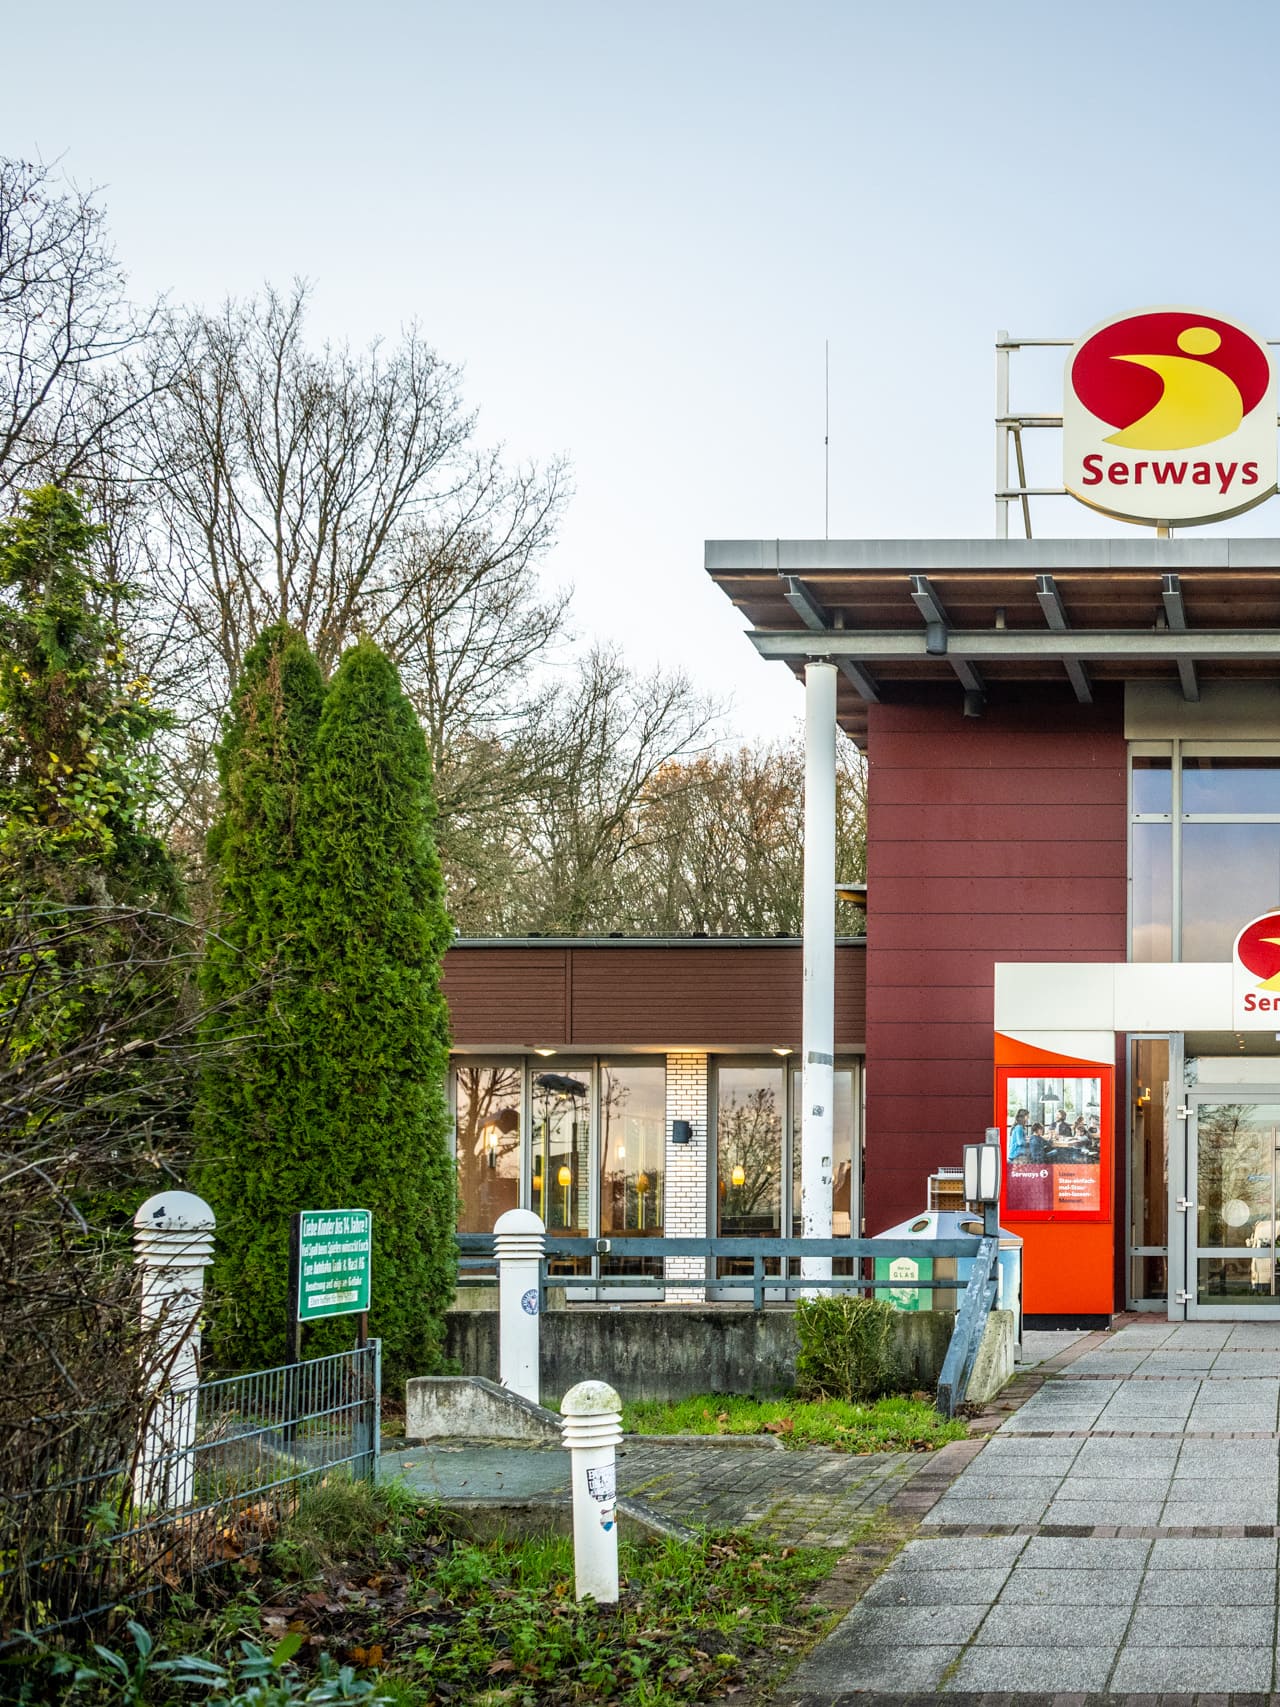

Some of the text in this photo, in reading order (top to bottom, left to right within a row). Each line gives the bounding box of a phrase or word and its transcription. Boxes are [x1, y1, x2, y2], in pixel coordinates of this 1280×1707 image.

[1082, 453, 1259, 494] Serways
[1011, 1170, 1039, 1179] Serways
[303, 1217, 318, 1237] Liebe
[318, 1217, 335, 1236] Kinder
[335, 1216, 343, 1235] bis
